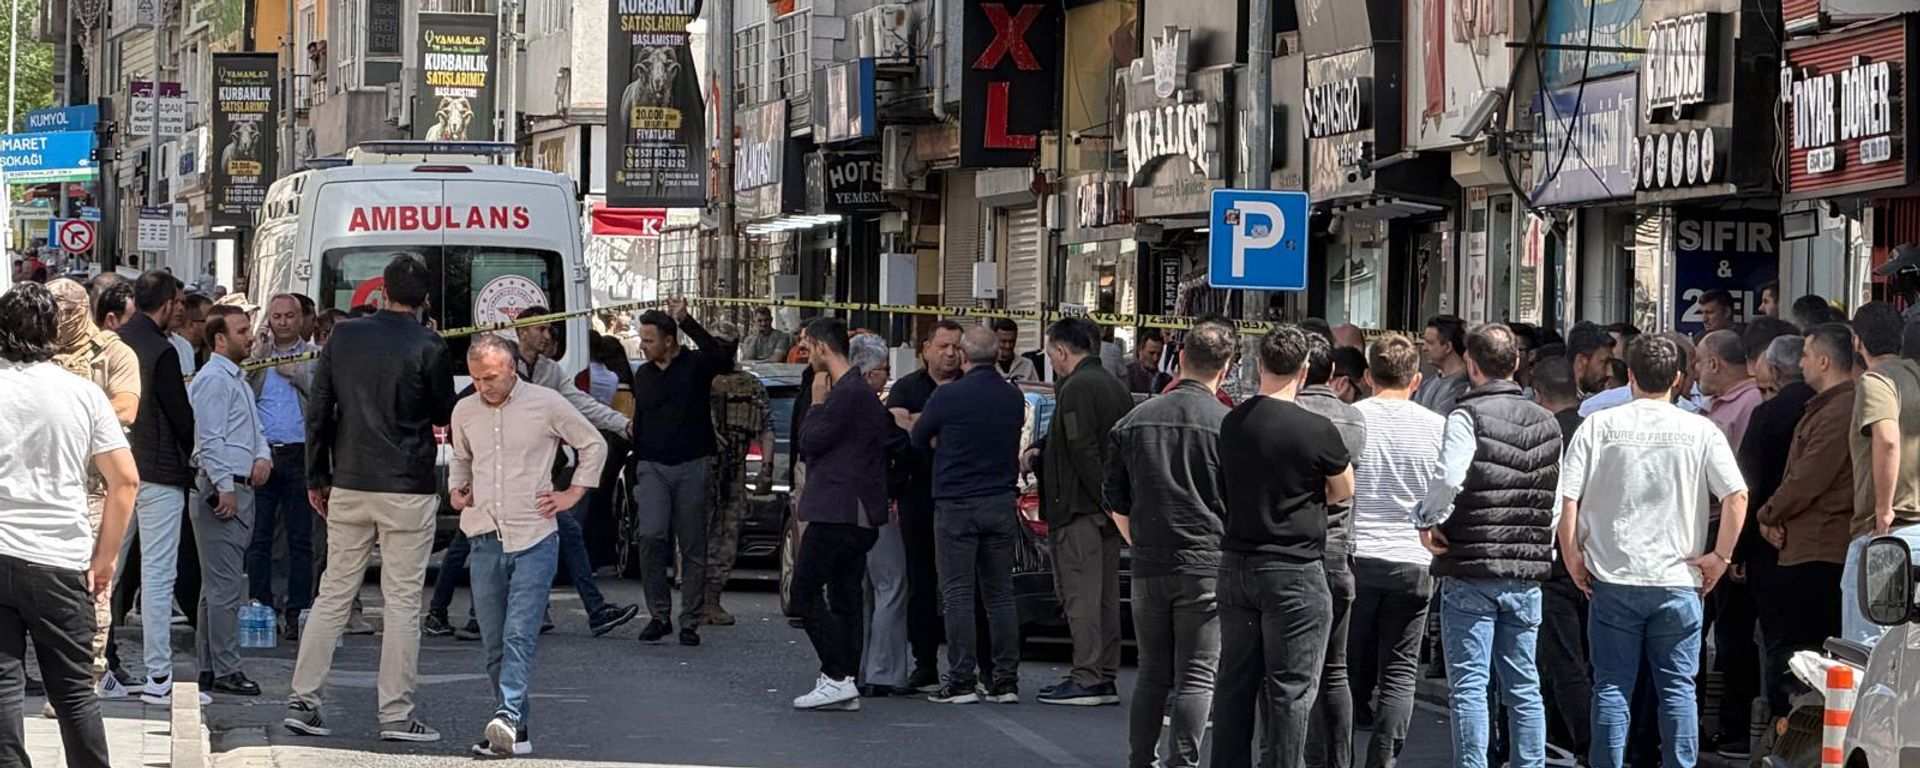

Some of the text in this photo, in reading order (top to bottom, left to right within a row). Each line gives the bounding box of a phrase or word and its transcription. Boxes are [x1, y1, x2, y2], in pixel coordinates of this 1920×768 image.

[435, 35, 486, 45] YAMANLAR
[425, 53, 488, 72] KURBANLIK
[227, 70, 268, 78] YAMANLAR
[426, 71, 485, 87] SATIŞLARIMIZ
[219, 87, 272, 101] KURBANLIK
[1781, 56, 1890, 149] ÖZ DİYAR DÖNER
[30, 111, 69, 127] KUMYOL
[2, 137, 47, 151] MARET
[1126, 90, 1208, 188] KRALİÇE
[0, 154, 43, 167] SOKAĞI
[829, 161, 883, 189] HOTE
[348, 206, 530, 231] AMBULANS
[1677, 219, 1773, 253] SIFIR
[1717, 260, 1733, 278] &
[1597, 429, 1633, 441] FUTURE
[1648, 432, 1695, 443] FREEDOM
